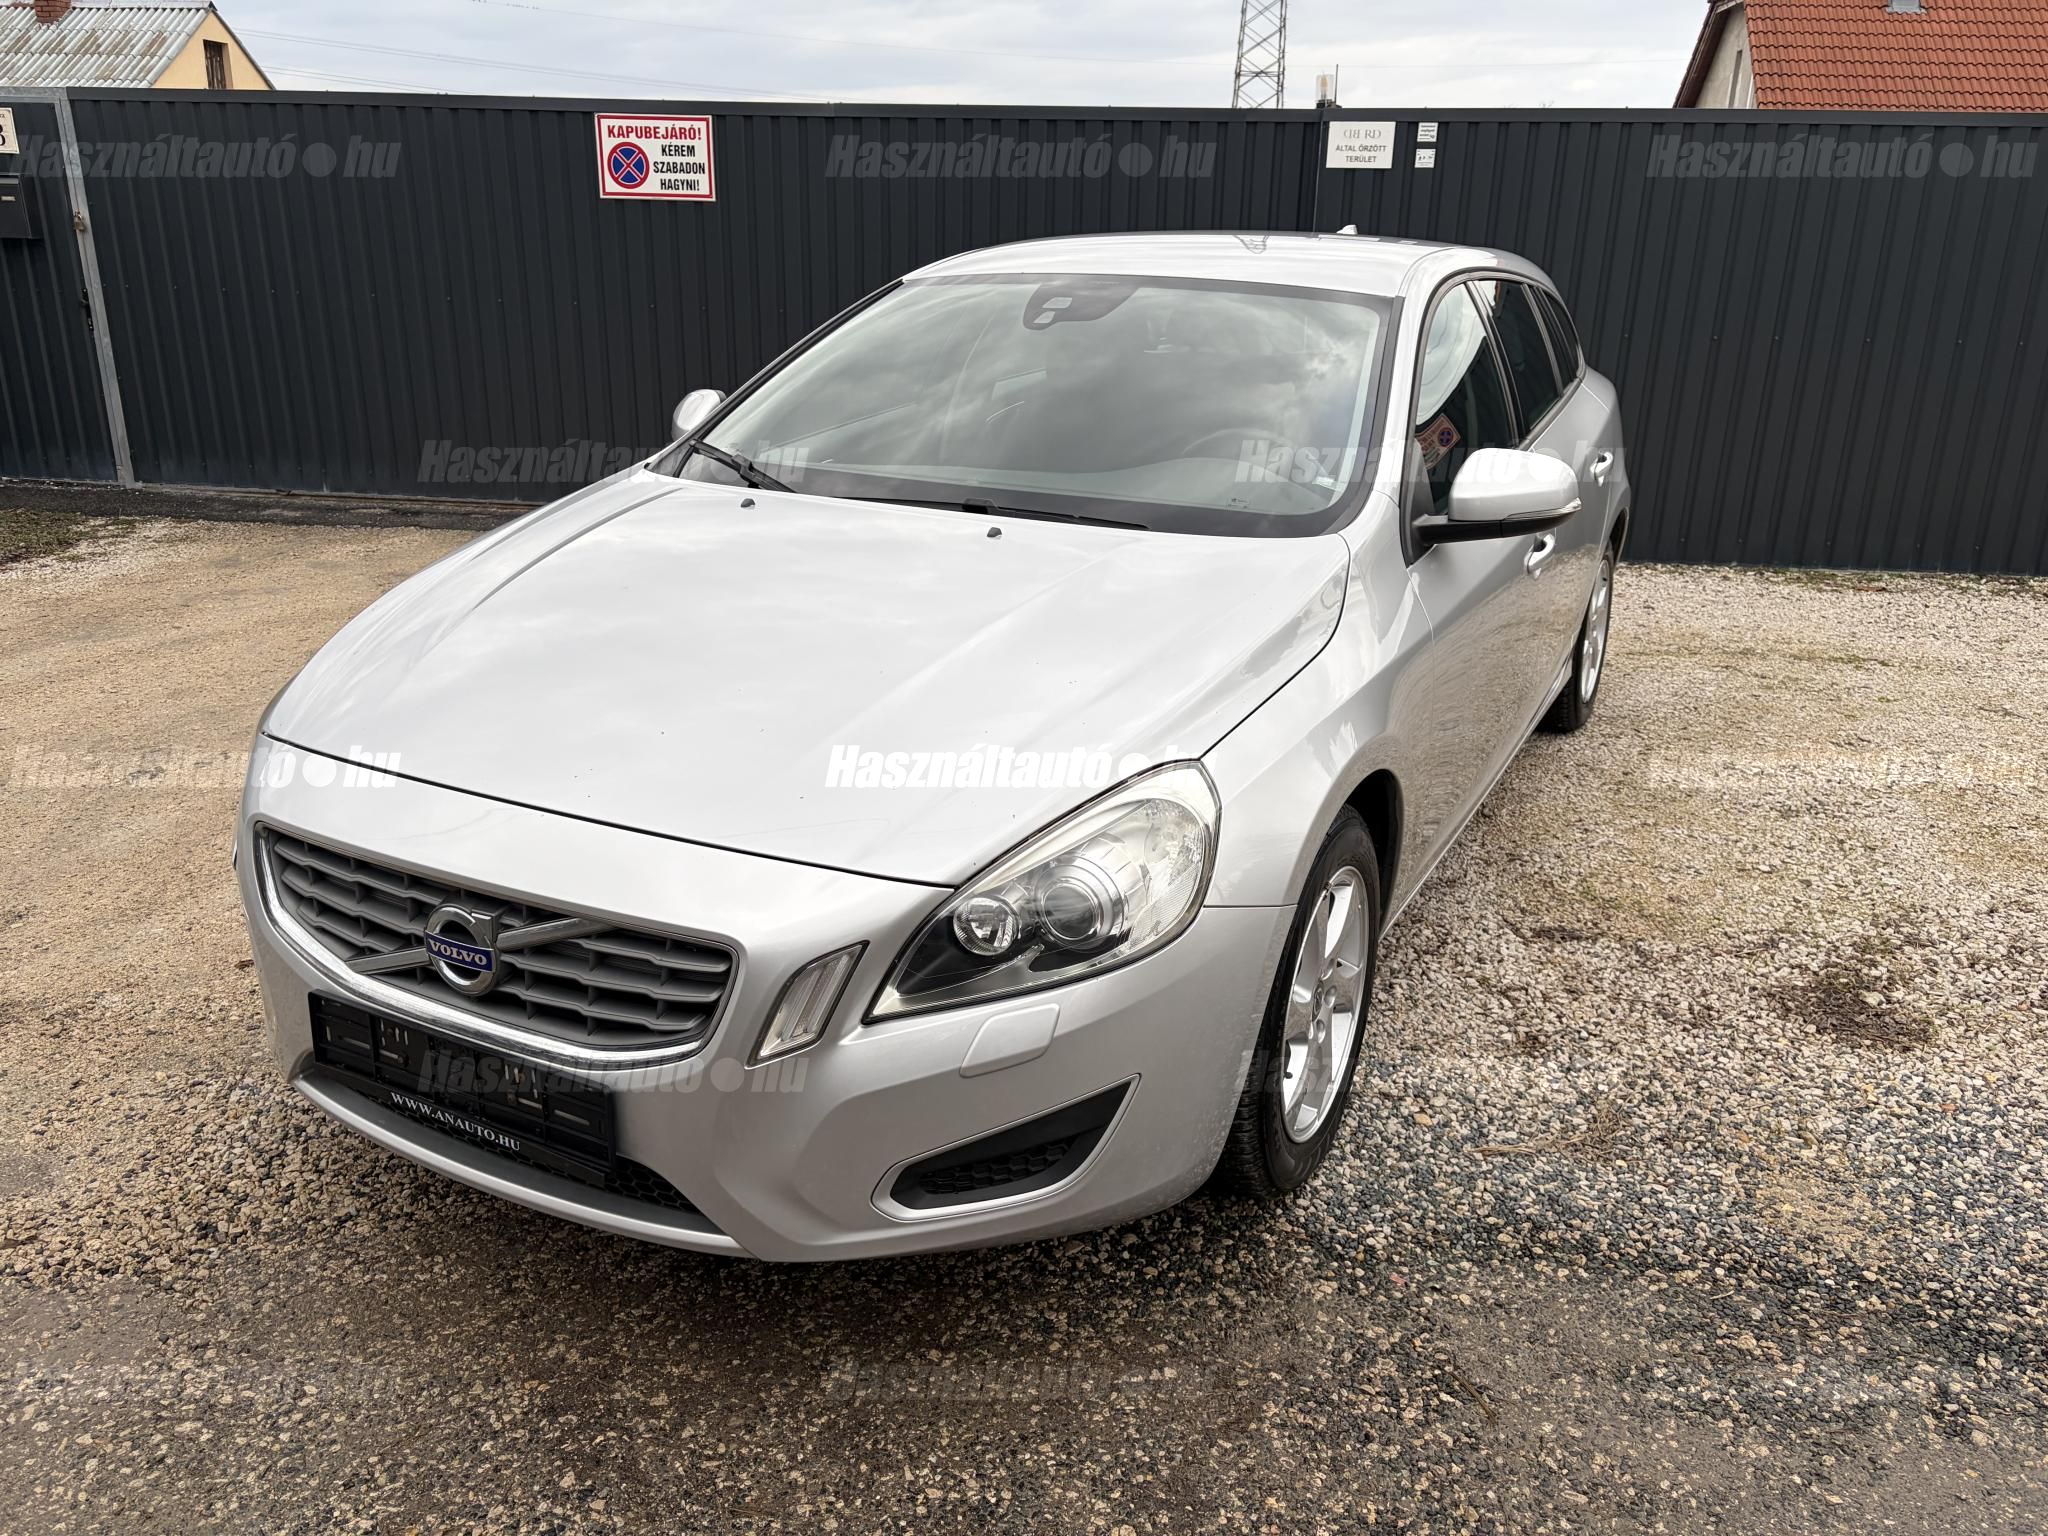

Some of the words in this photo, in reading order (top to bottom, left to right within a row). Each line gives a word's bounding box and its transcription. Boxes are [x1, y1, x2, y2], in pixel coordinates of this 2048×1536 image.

[607, 124, 702, 140] KAPUBEJÁRÓ!
[661, 142, 695, 157] KÉREM
[653, 161, 705, 174] SZABADON
[660, 178, 700, 191] HAGYNI!
[428, 939, 487, 966] VOLVO
[390, 1092, 520, 1151] WWW.ANAUTO.HU
